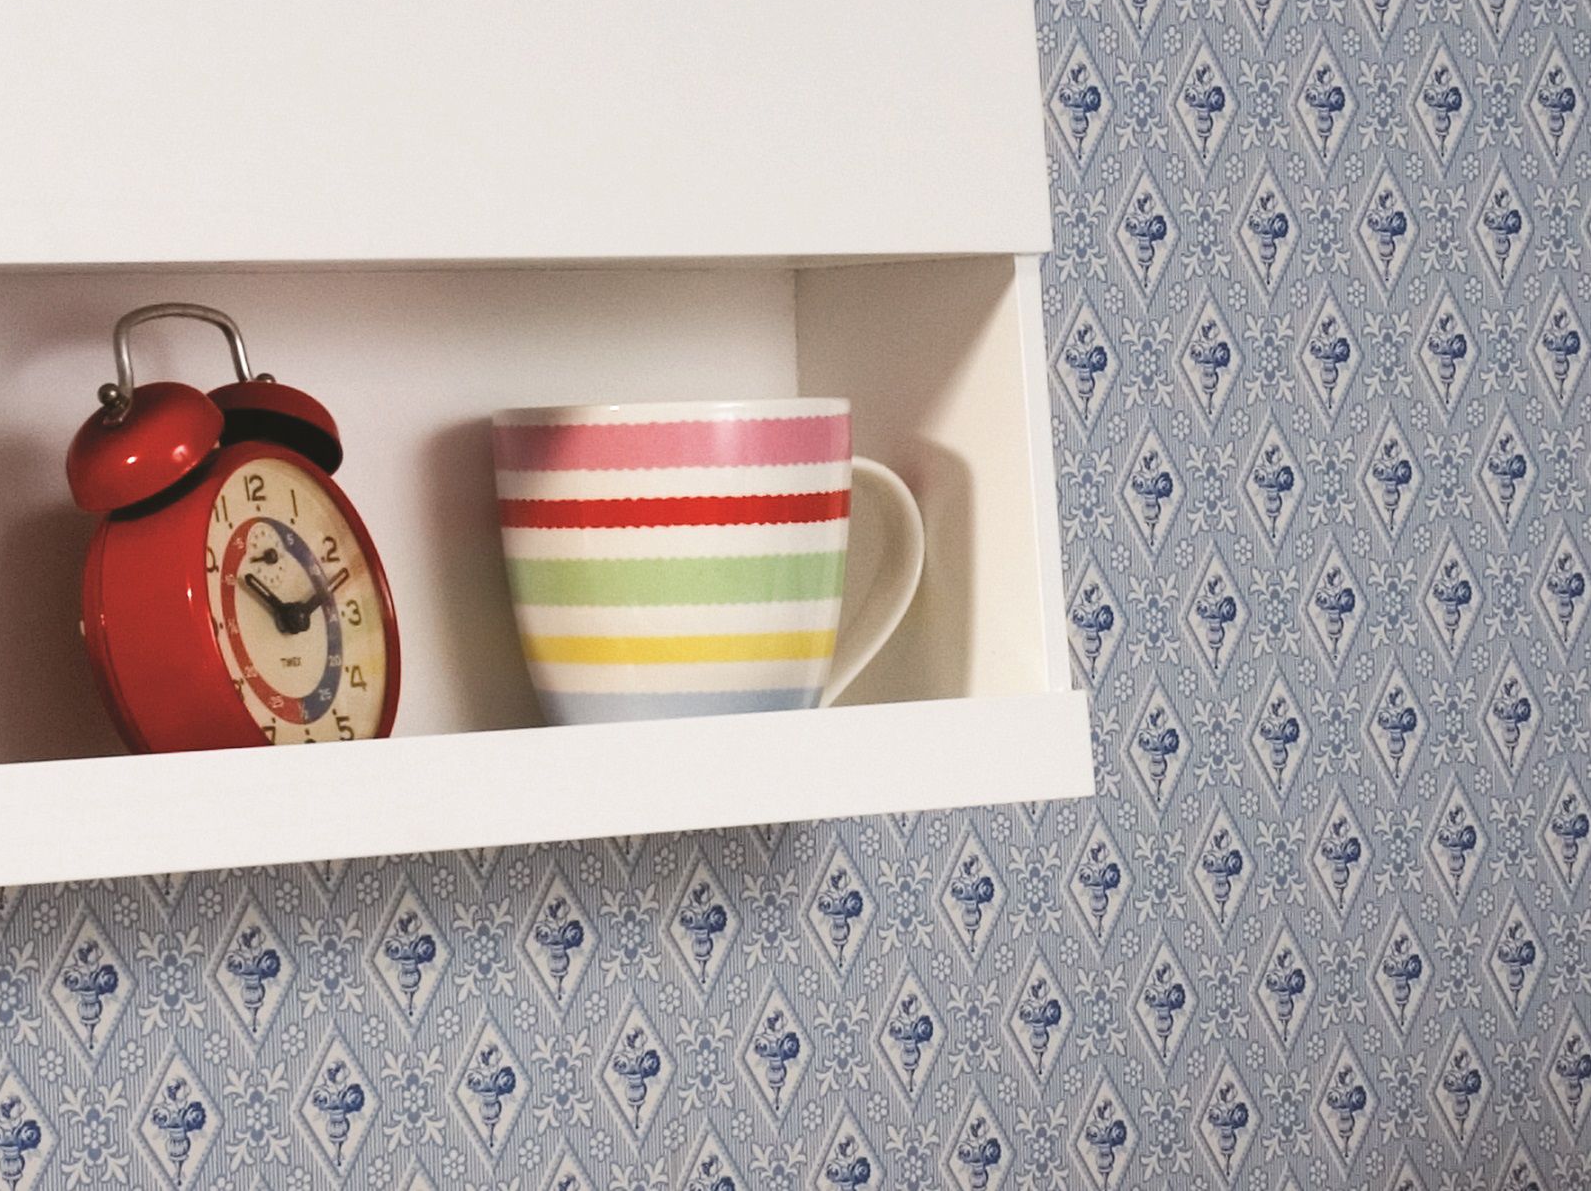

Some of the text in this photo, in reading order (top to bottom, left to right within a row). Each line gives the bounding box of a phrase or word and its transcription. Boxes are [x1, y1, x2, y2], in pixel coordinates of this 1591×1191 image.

[244, 474, 267, 502] 12
[290, 489, 299, 517] 1
[322, 536, 340, 563] 2
[346, 599, 362, 626] 3
[350, 665, 367, 692] 4
[336, 716, 355, 741] 5
